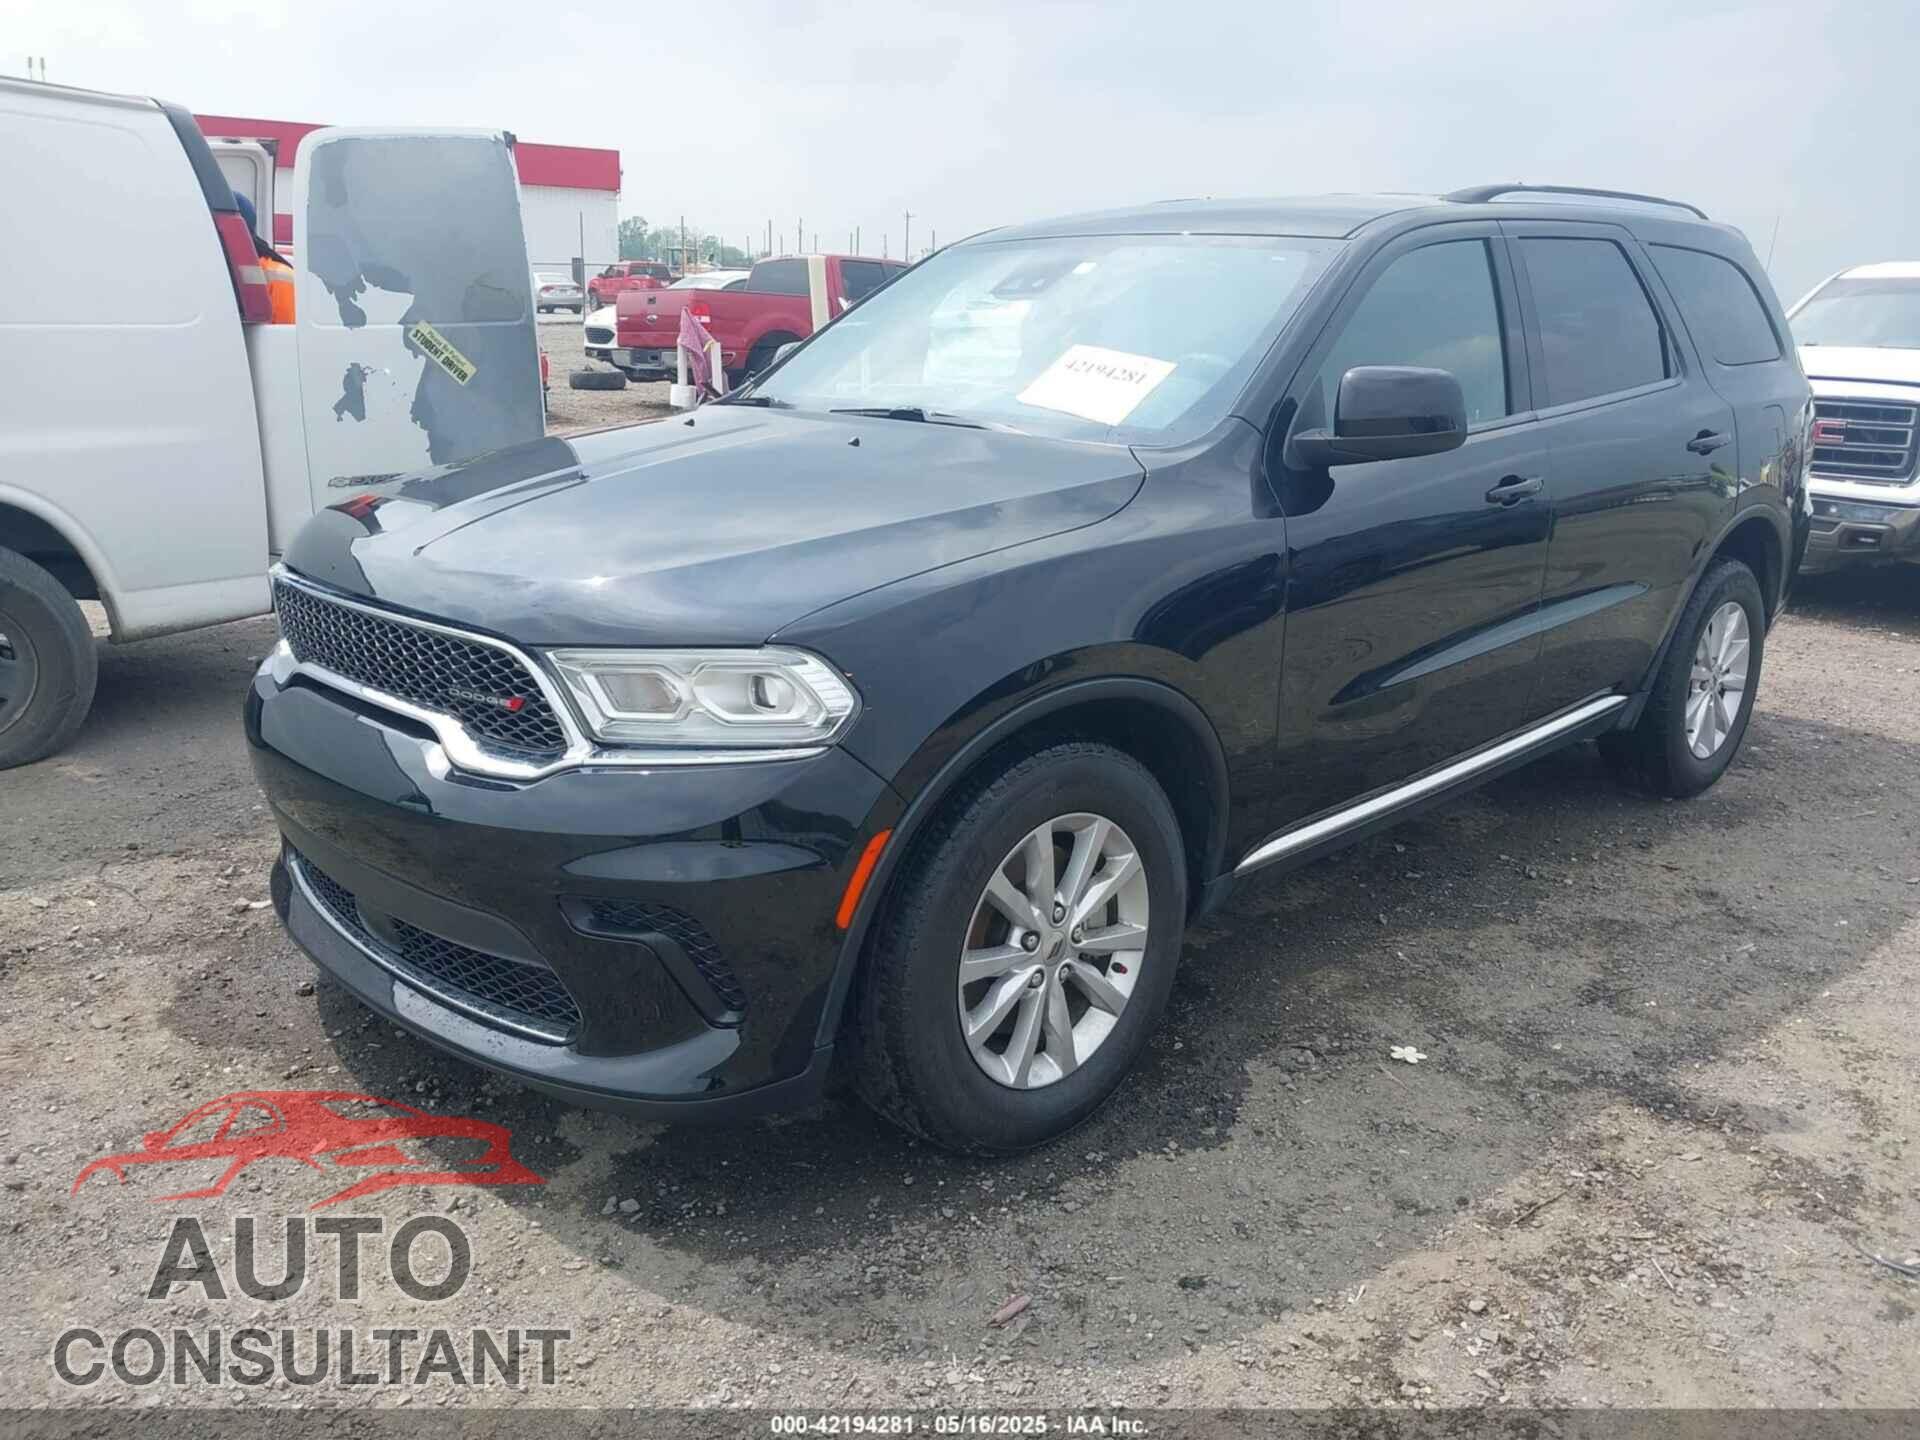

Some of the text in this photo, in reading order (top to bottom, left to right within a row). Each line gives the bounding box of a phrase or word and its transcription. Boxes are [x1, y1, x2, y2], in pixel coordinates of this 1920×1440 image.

[412, 328, 469, 382] STUDENT DRIVER
[1064, 358, 1147, 385] 42194281
[448, 687, 509, 708] DODGE
